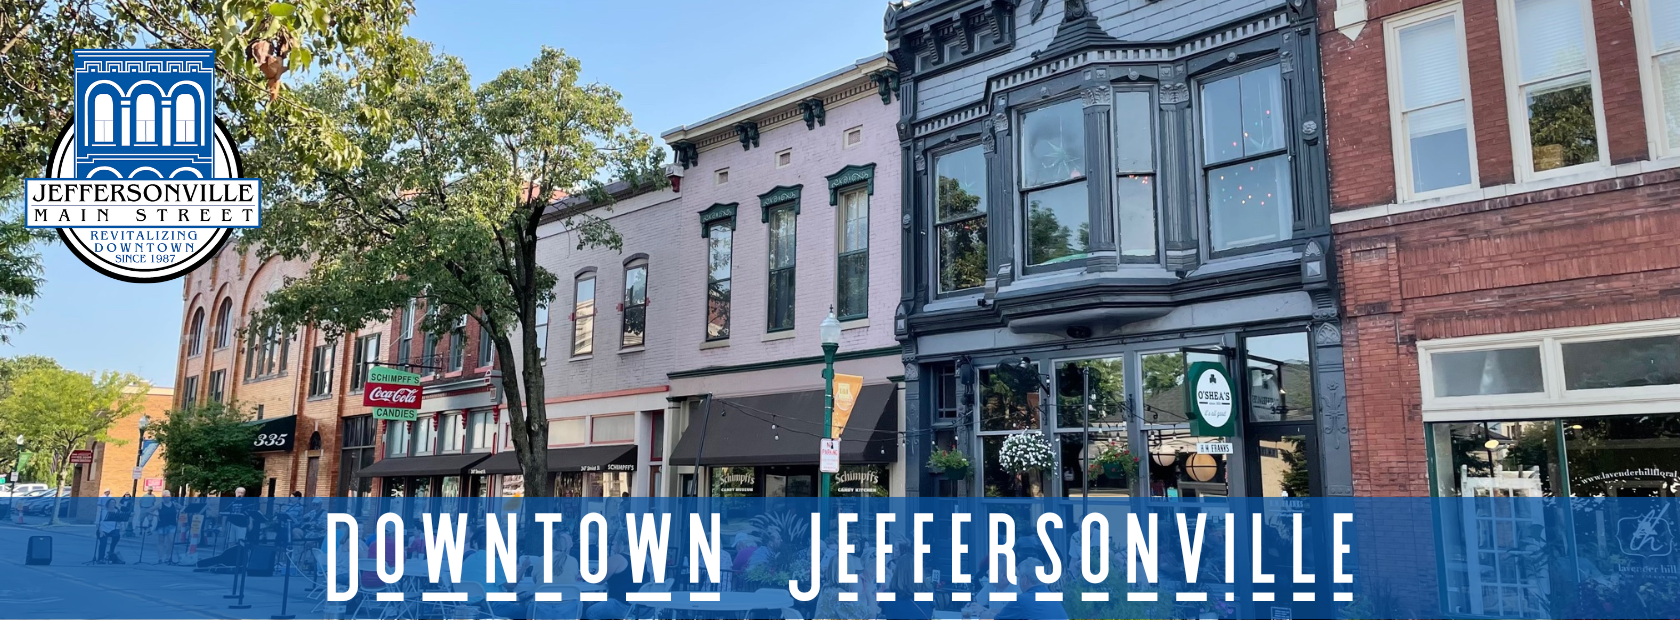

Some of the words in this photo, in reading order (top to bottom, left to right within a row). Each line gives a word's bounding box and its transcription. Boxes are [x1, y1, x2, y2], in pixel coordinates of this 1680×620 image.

[371, 373, 420, 384] SCHIMPFF'S
[369, 386, 418, 403] Coca-Cola
[1198, 391, 1231, 401] O'SHEA'S
[376, 408, 415, 419] CANDIES
[253, 433, 288, 447] 335
